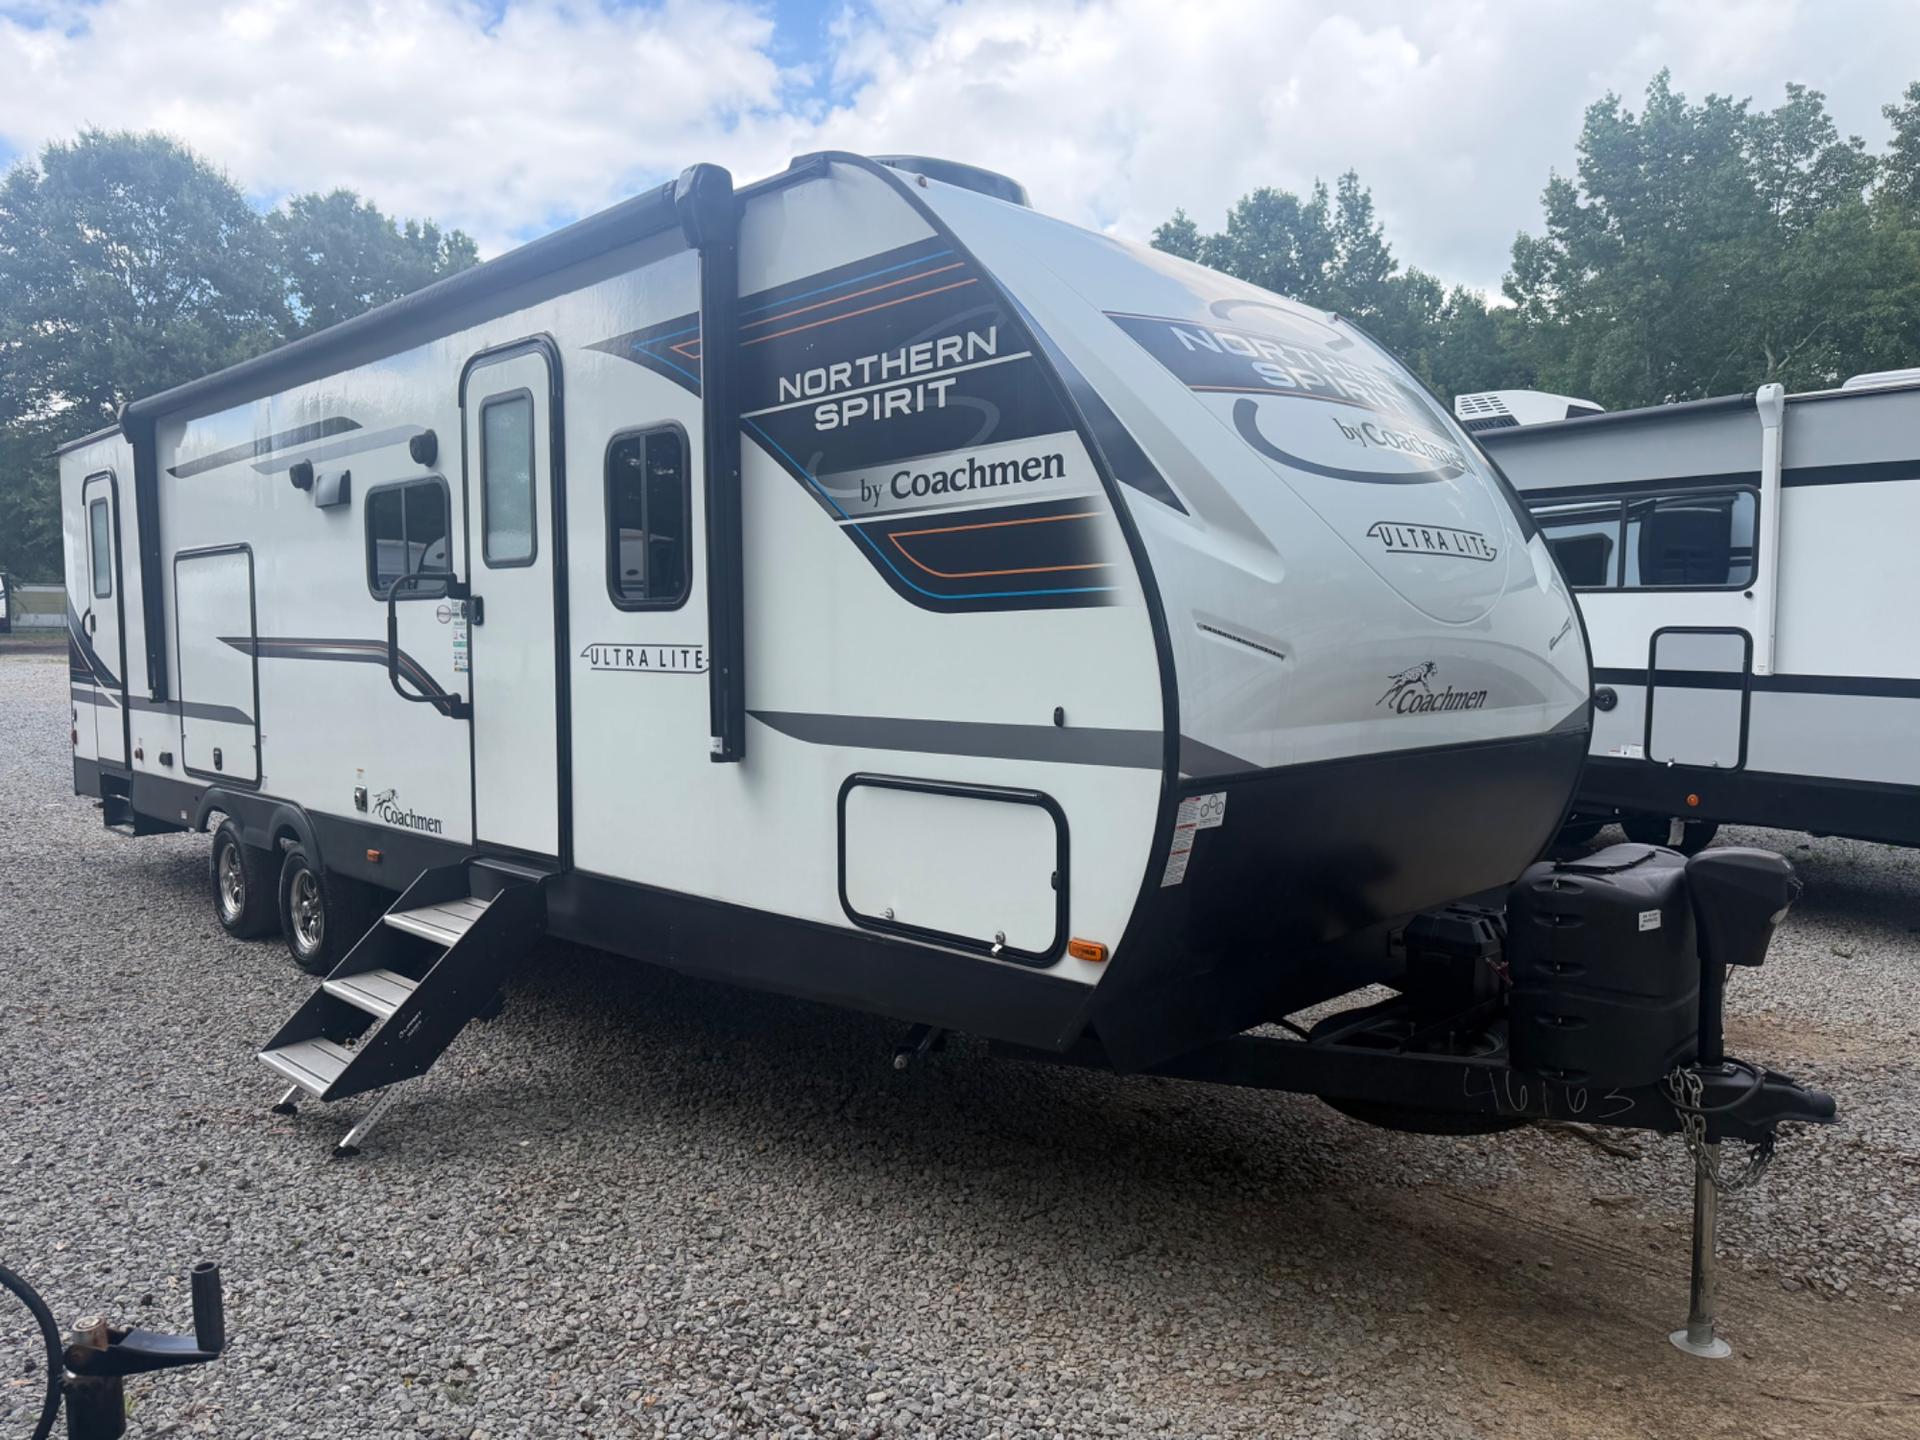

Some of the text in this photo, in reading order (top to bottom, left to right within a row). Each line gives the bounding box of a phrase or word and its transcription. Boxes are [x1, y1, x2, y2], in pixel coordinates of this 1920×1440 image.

[779, 326, 997, 402] NORTHERN
[1252, 361, 1407, 416] SPIRIT
[814, 377, 957, 431] SPIRIT
[1332, 417, 1477, 477] by Coachmen
[860, 452, 1066, 507] by Coachmen
[1378, 526, 1491, 557] ULTRA LITE
[590, 647, 703, 669] ULTRA LITE
[1396, 686, 1488, 715] Coachmen
[384, 805, 442, 834] Coachmen
